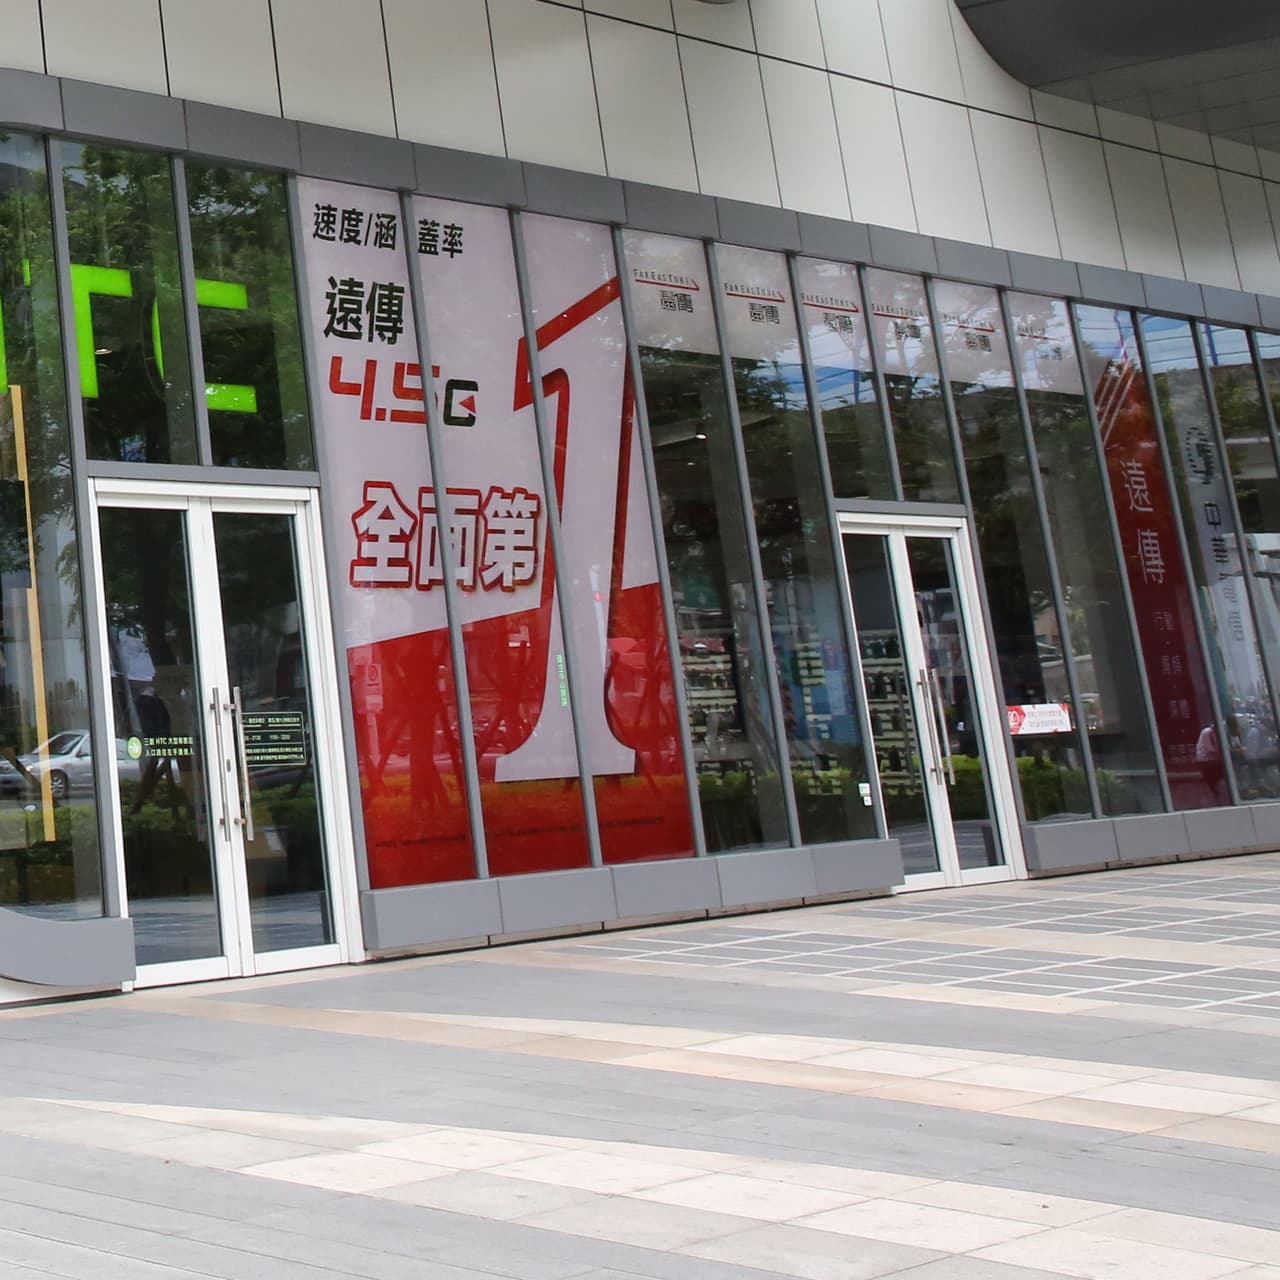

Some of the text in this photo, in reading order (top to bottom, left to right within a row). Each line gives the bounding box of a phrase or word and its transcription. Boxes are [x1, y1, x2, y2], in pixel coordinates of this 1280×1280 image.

[313, 203, 464, 259] 速度/涵蓋率
[324, 276, 405, 345] 遠傳
